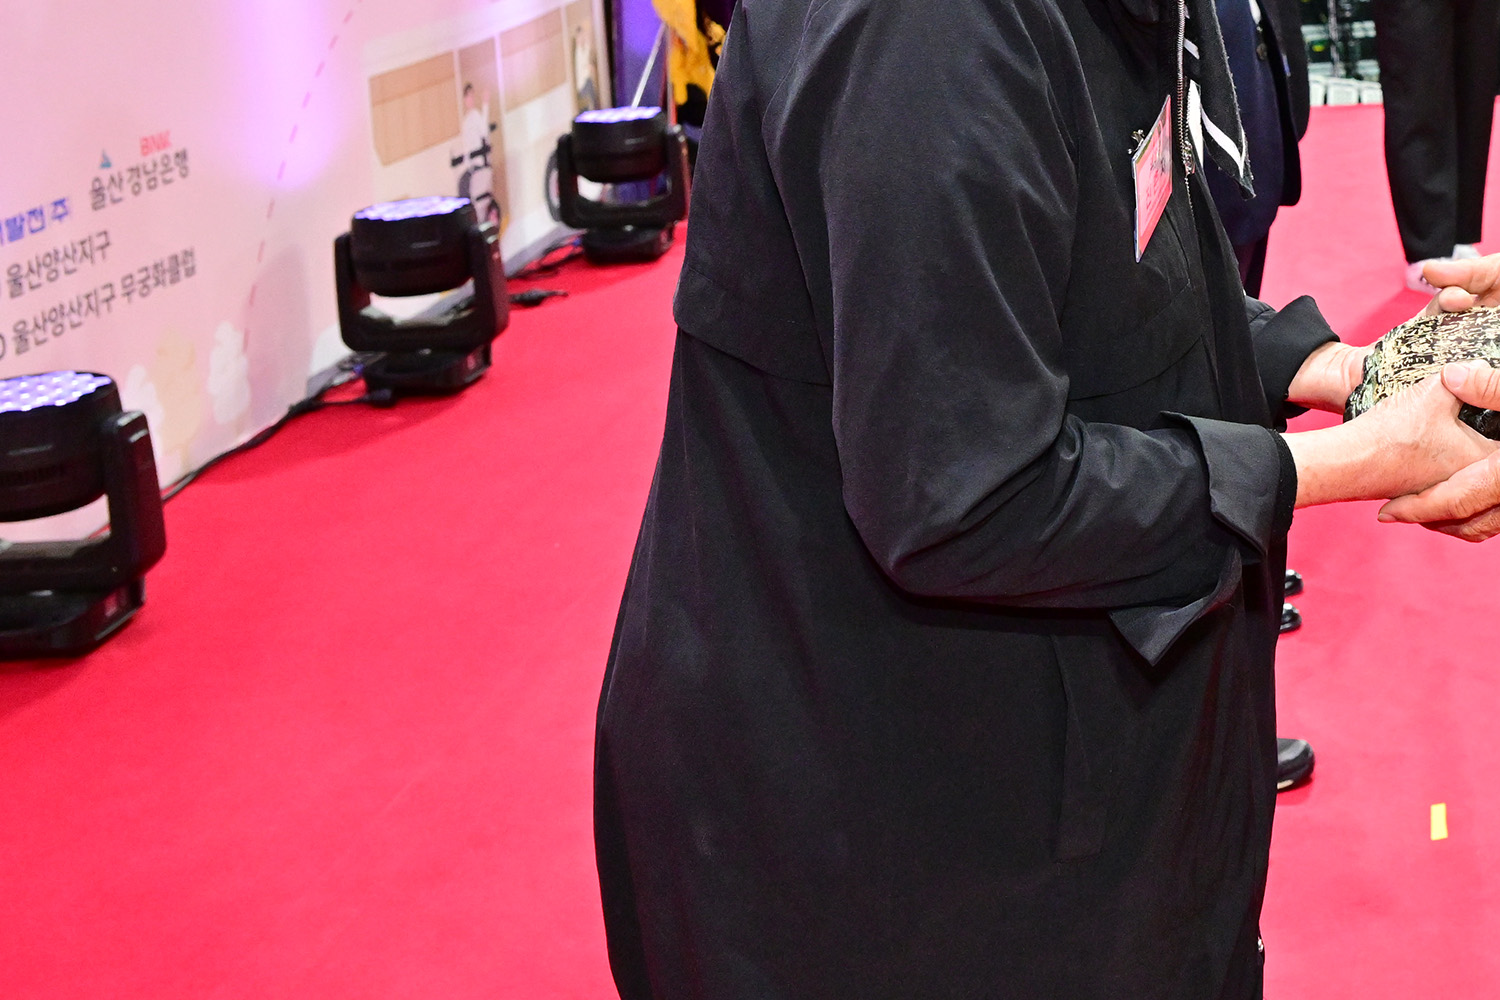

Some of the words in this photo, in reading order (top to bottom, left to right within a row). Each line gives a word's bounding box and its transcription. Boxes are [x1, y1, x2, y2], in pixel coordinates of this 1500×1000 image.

[140, 130, 172, 157] BNK
[0, 206, 46, 246] 발전
[7, 230, 111, 299] 울산양산지구
[13, 282, 116, 355] 울산양산지구
[121, 247, 197, 304] 무궁화클럽
